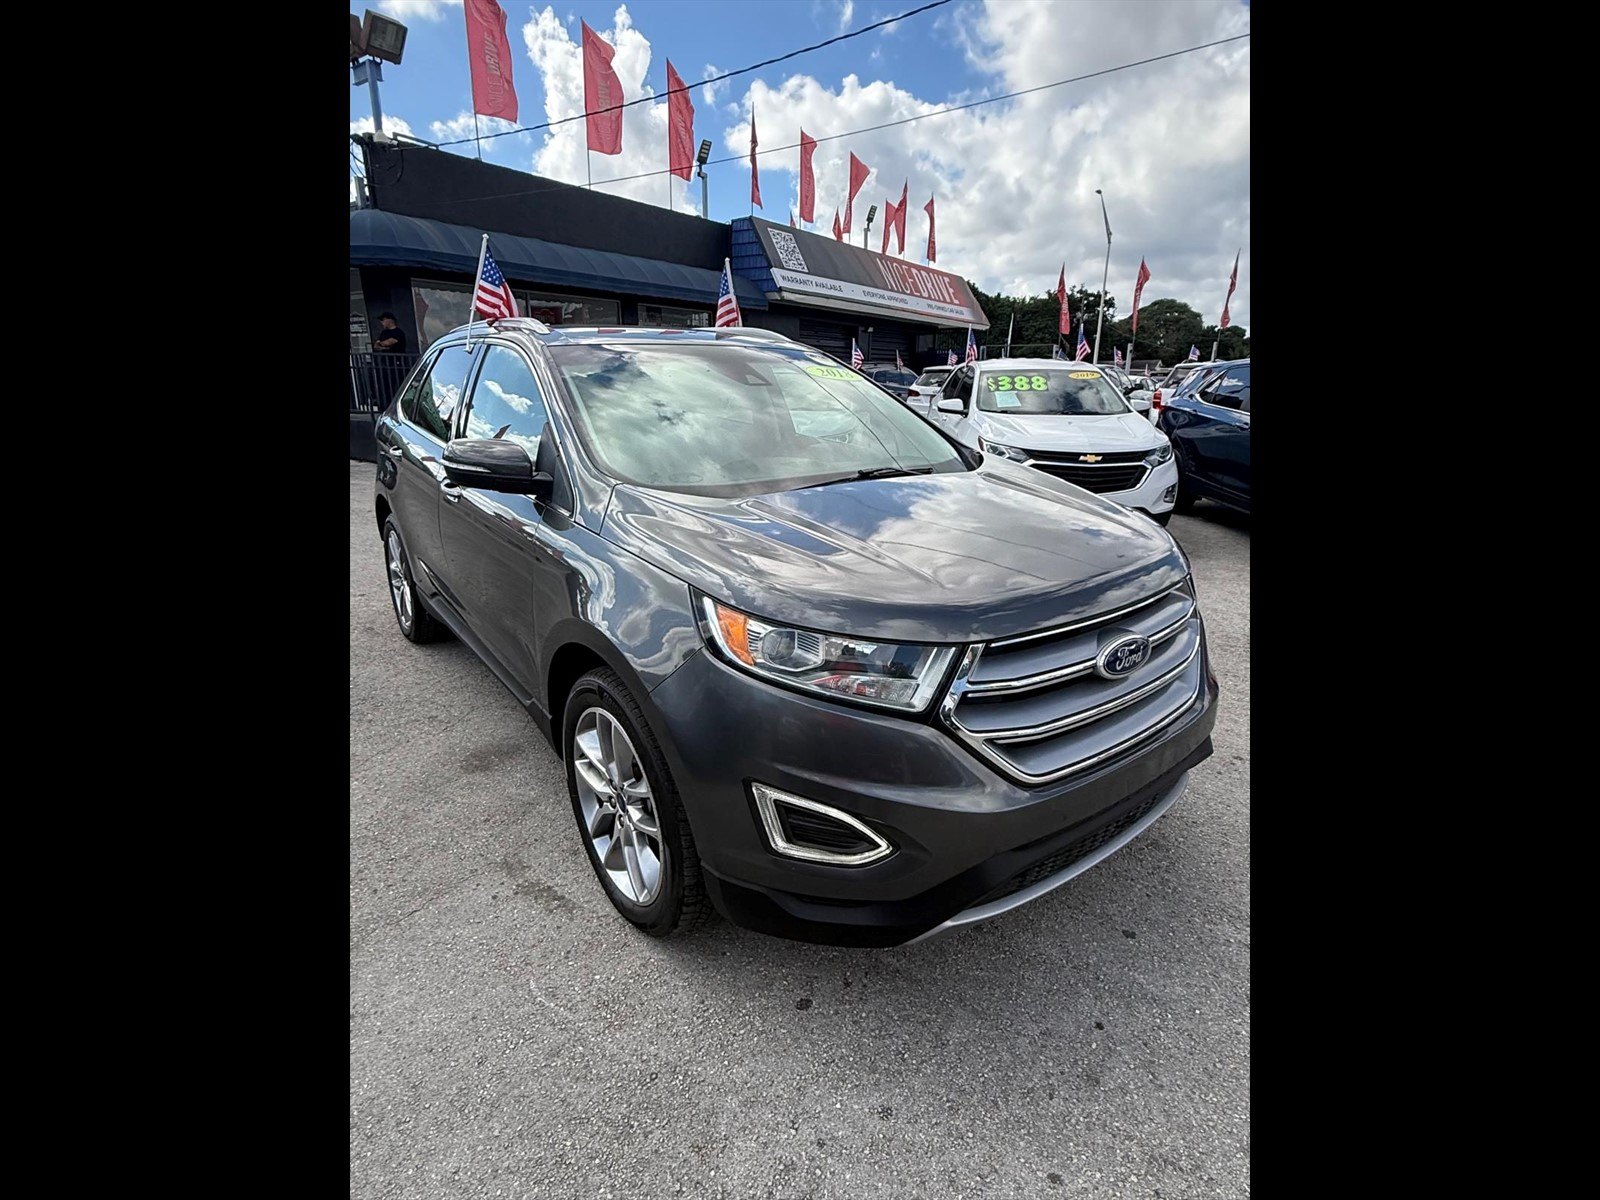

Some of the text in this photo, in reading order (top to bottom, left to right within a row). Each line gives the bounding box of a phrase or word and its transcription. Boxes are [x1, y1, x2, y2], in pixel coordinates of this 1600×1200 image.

[780, 274, 844, 293] WARRANTY AVAILABLE
[987, 375, 1048, 391] $388
[1115, 643, 1144, 671] Ford
